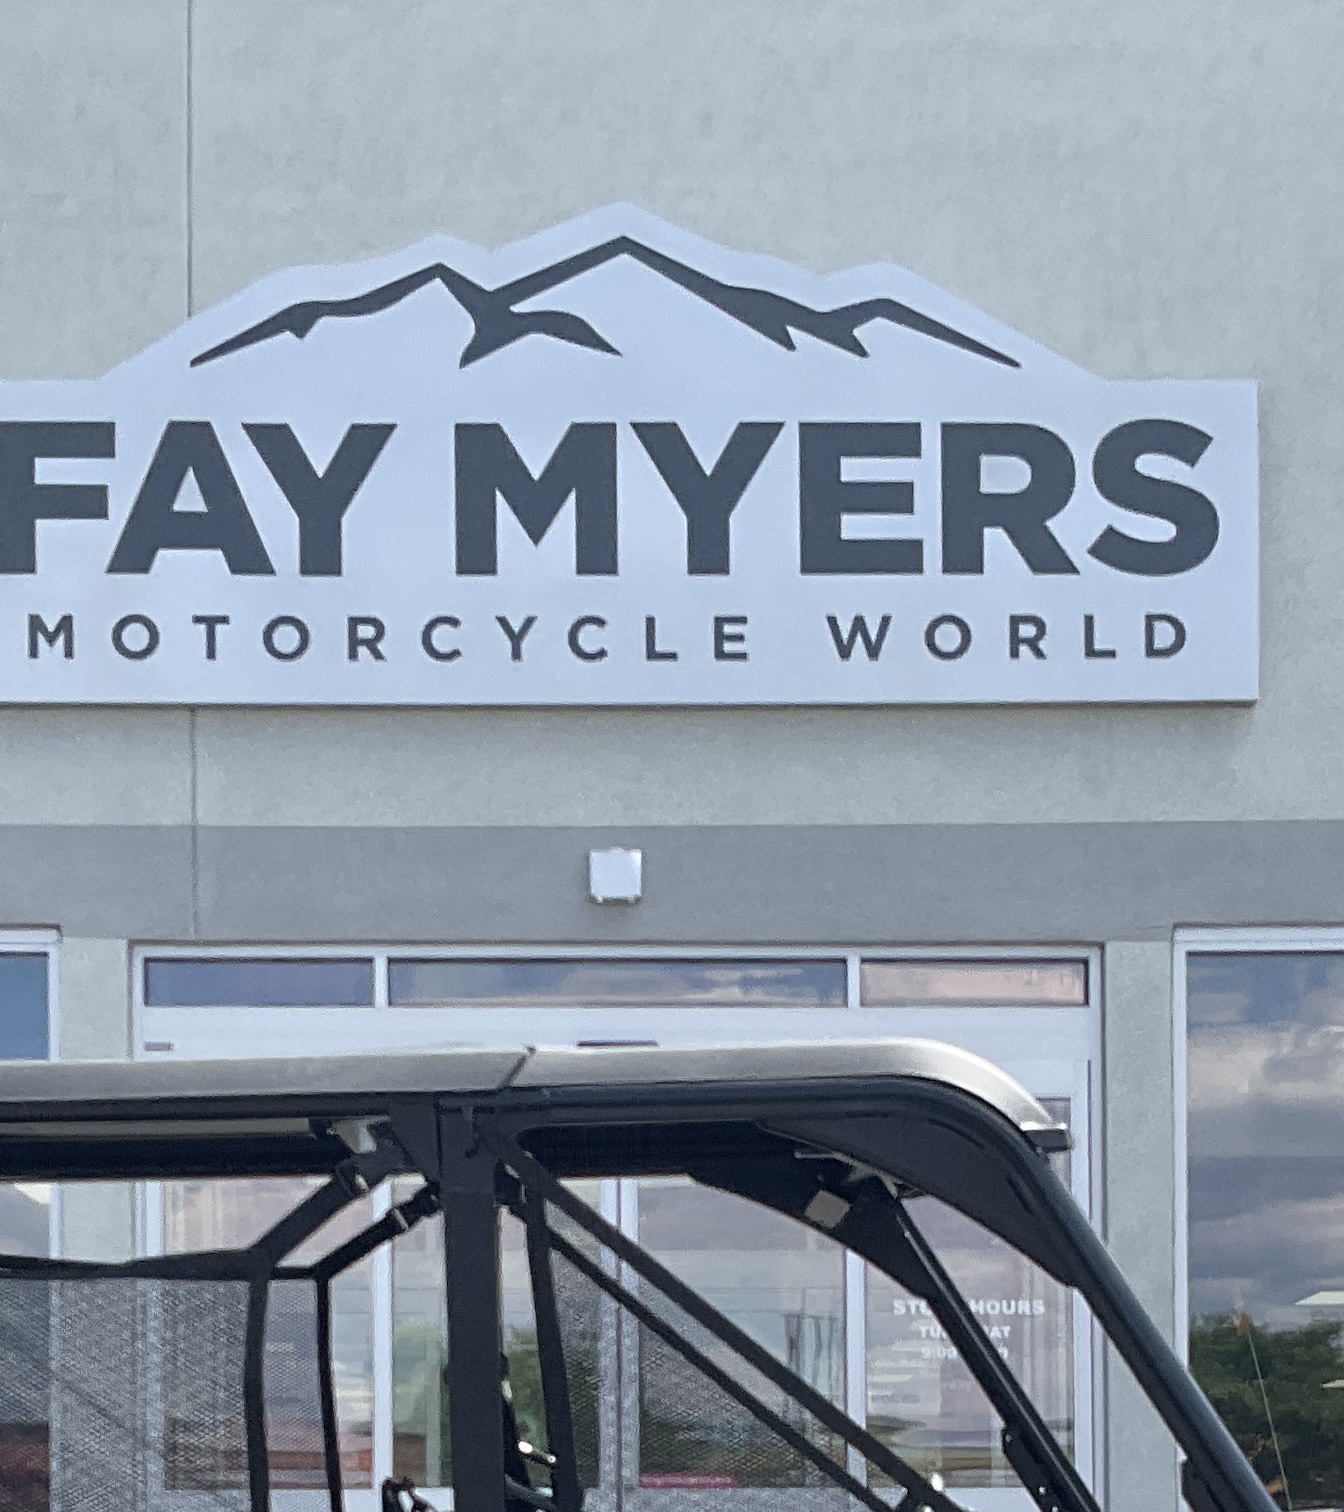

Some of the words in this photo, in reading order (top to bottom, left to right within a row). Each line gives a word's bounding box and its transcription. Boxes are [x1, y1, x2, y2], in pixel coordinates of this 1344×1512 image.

[453, 417, 1221, 578] MYERS
[27, 613, 749, 662] MOTORCYCLE
[825, 612, 1188, 661] WORLD
[968, 1299, 1045, 1316] HOURS
